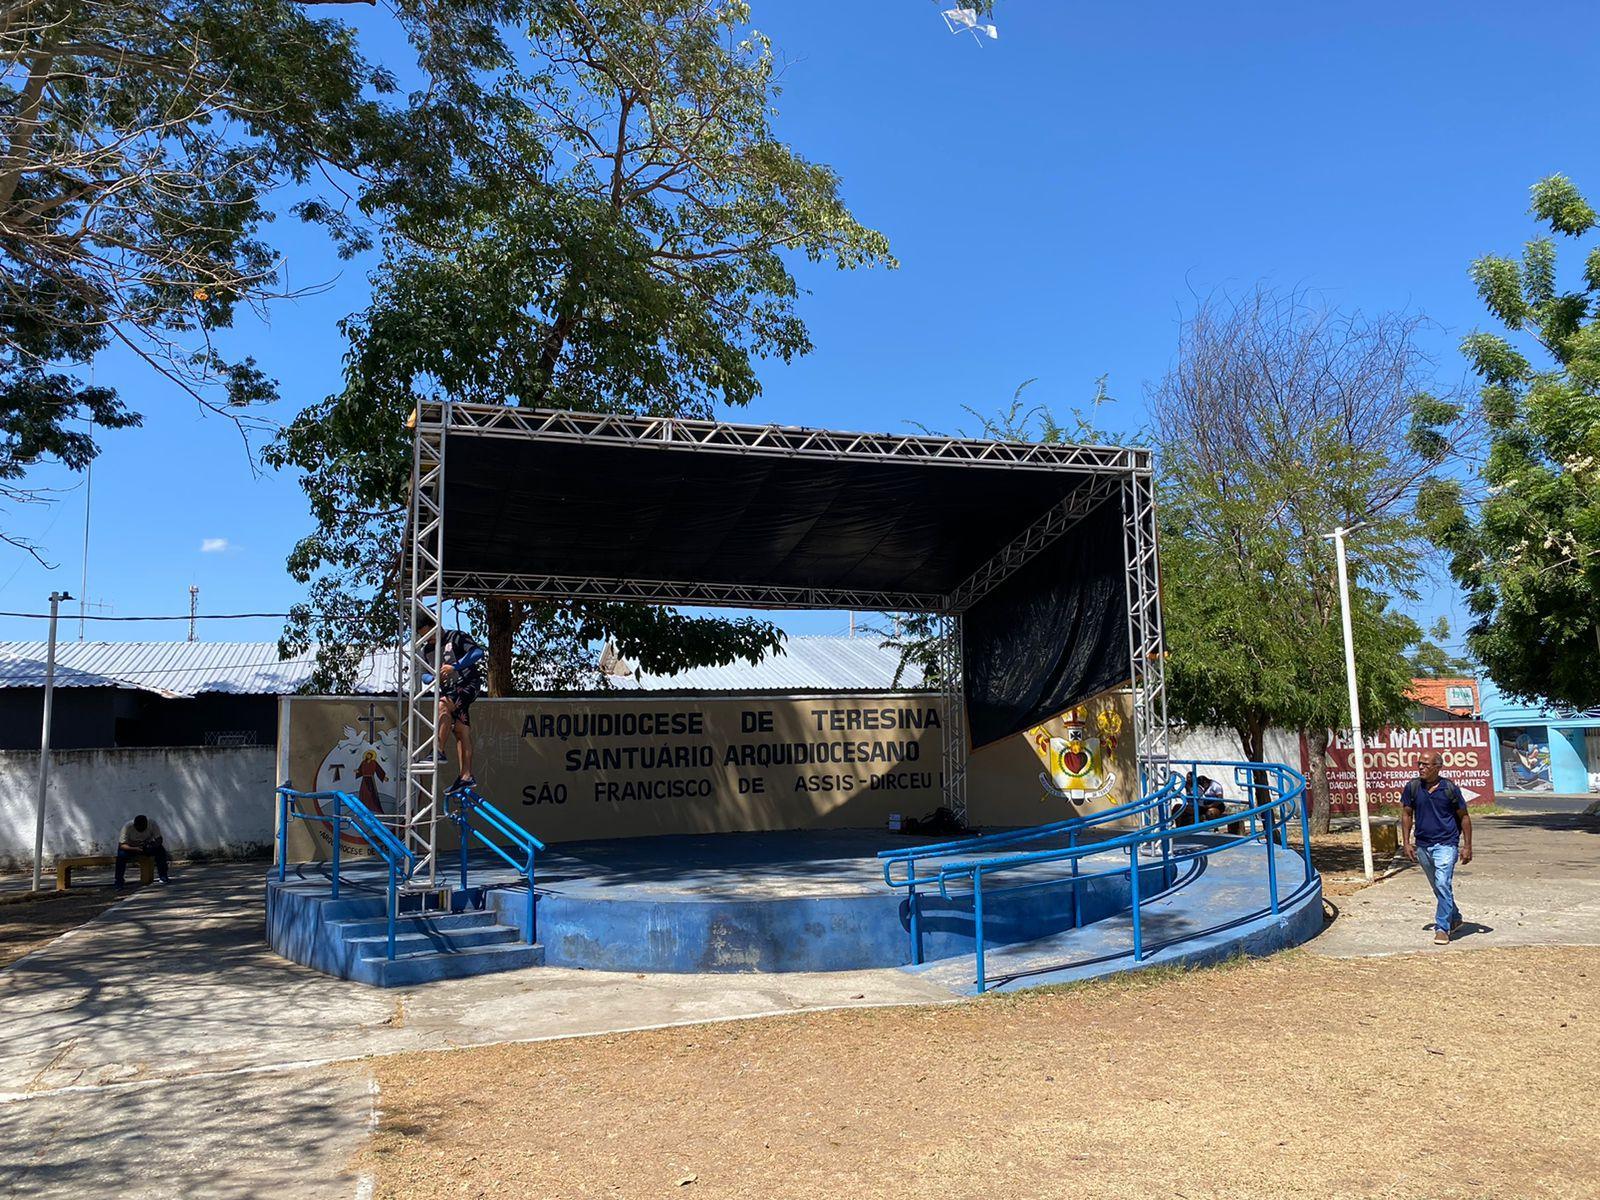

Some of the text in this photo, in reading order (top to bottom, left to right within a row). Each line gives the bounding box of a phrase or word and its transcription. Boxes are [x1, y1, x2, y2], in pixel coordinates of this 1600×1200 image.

[521, 708, 941, 741] ARQUIDIOCESE DE TERESINA
[1336, 727, 1487, 749] RAL MATERIAL
[565, 740, 920, 771] SANTUÁRIO ARQUIDIOCESANO
[1348, 748, 1478, 769] constrões
[1463, 769, 1490, 778] TINTAS
[522, 781, 568, 806] SÃO
[594, 779, 712, 802] FRANCISCO
[738, 777, 765, 794] DE
